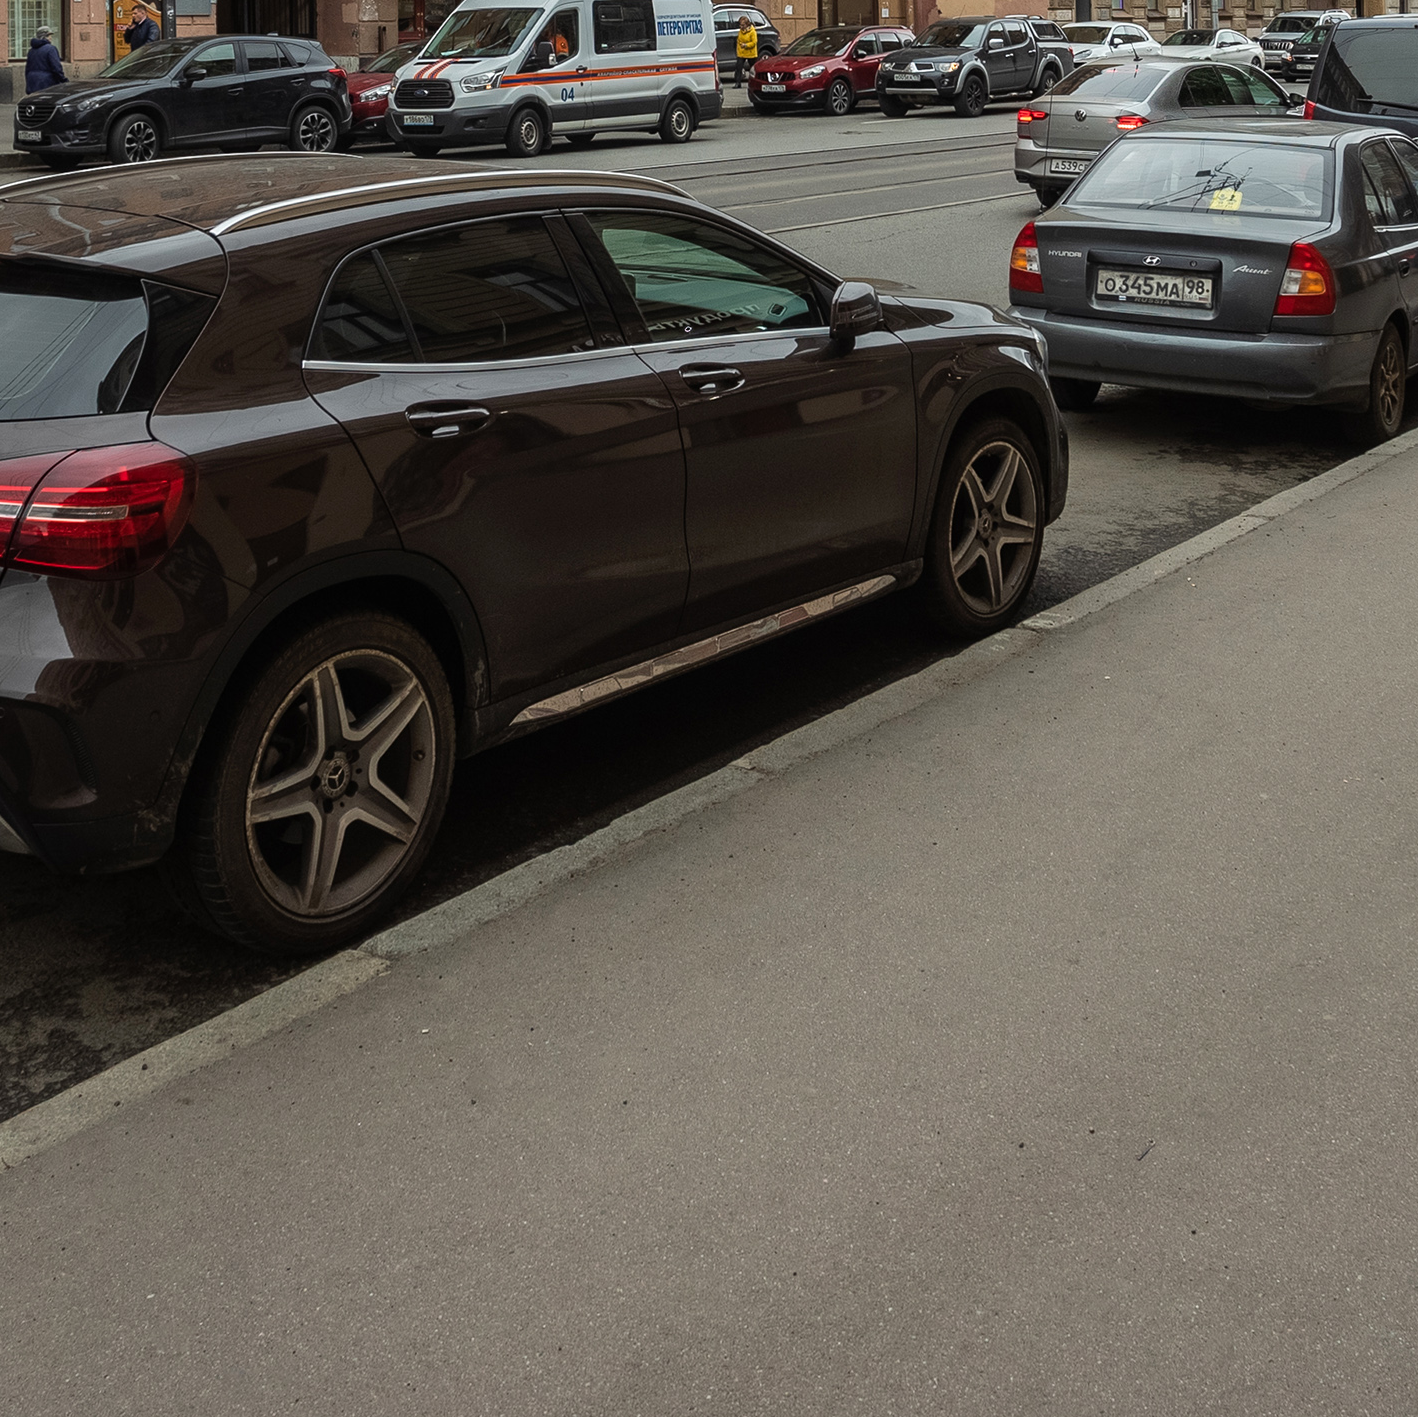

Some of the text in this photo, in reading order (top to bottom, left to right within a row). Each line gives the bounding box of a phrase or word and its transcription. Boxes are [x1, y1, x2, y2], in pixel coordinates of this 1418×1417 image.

[560, 86, 575, 102] 04
[1048, 249, 1082, 258] HYUNDAI
[1233, 264, 1273, 275] Accent
[1103, 274, 1206, 300] О345МА 98
[1134, 297, 1171, 306] RUSSIA
